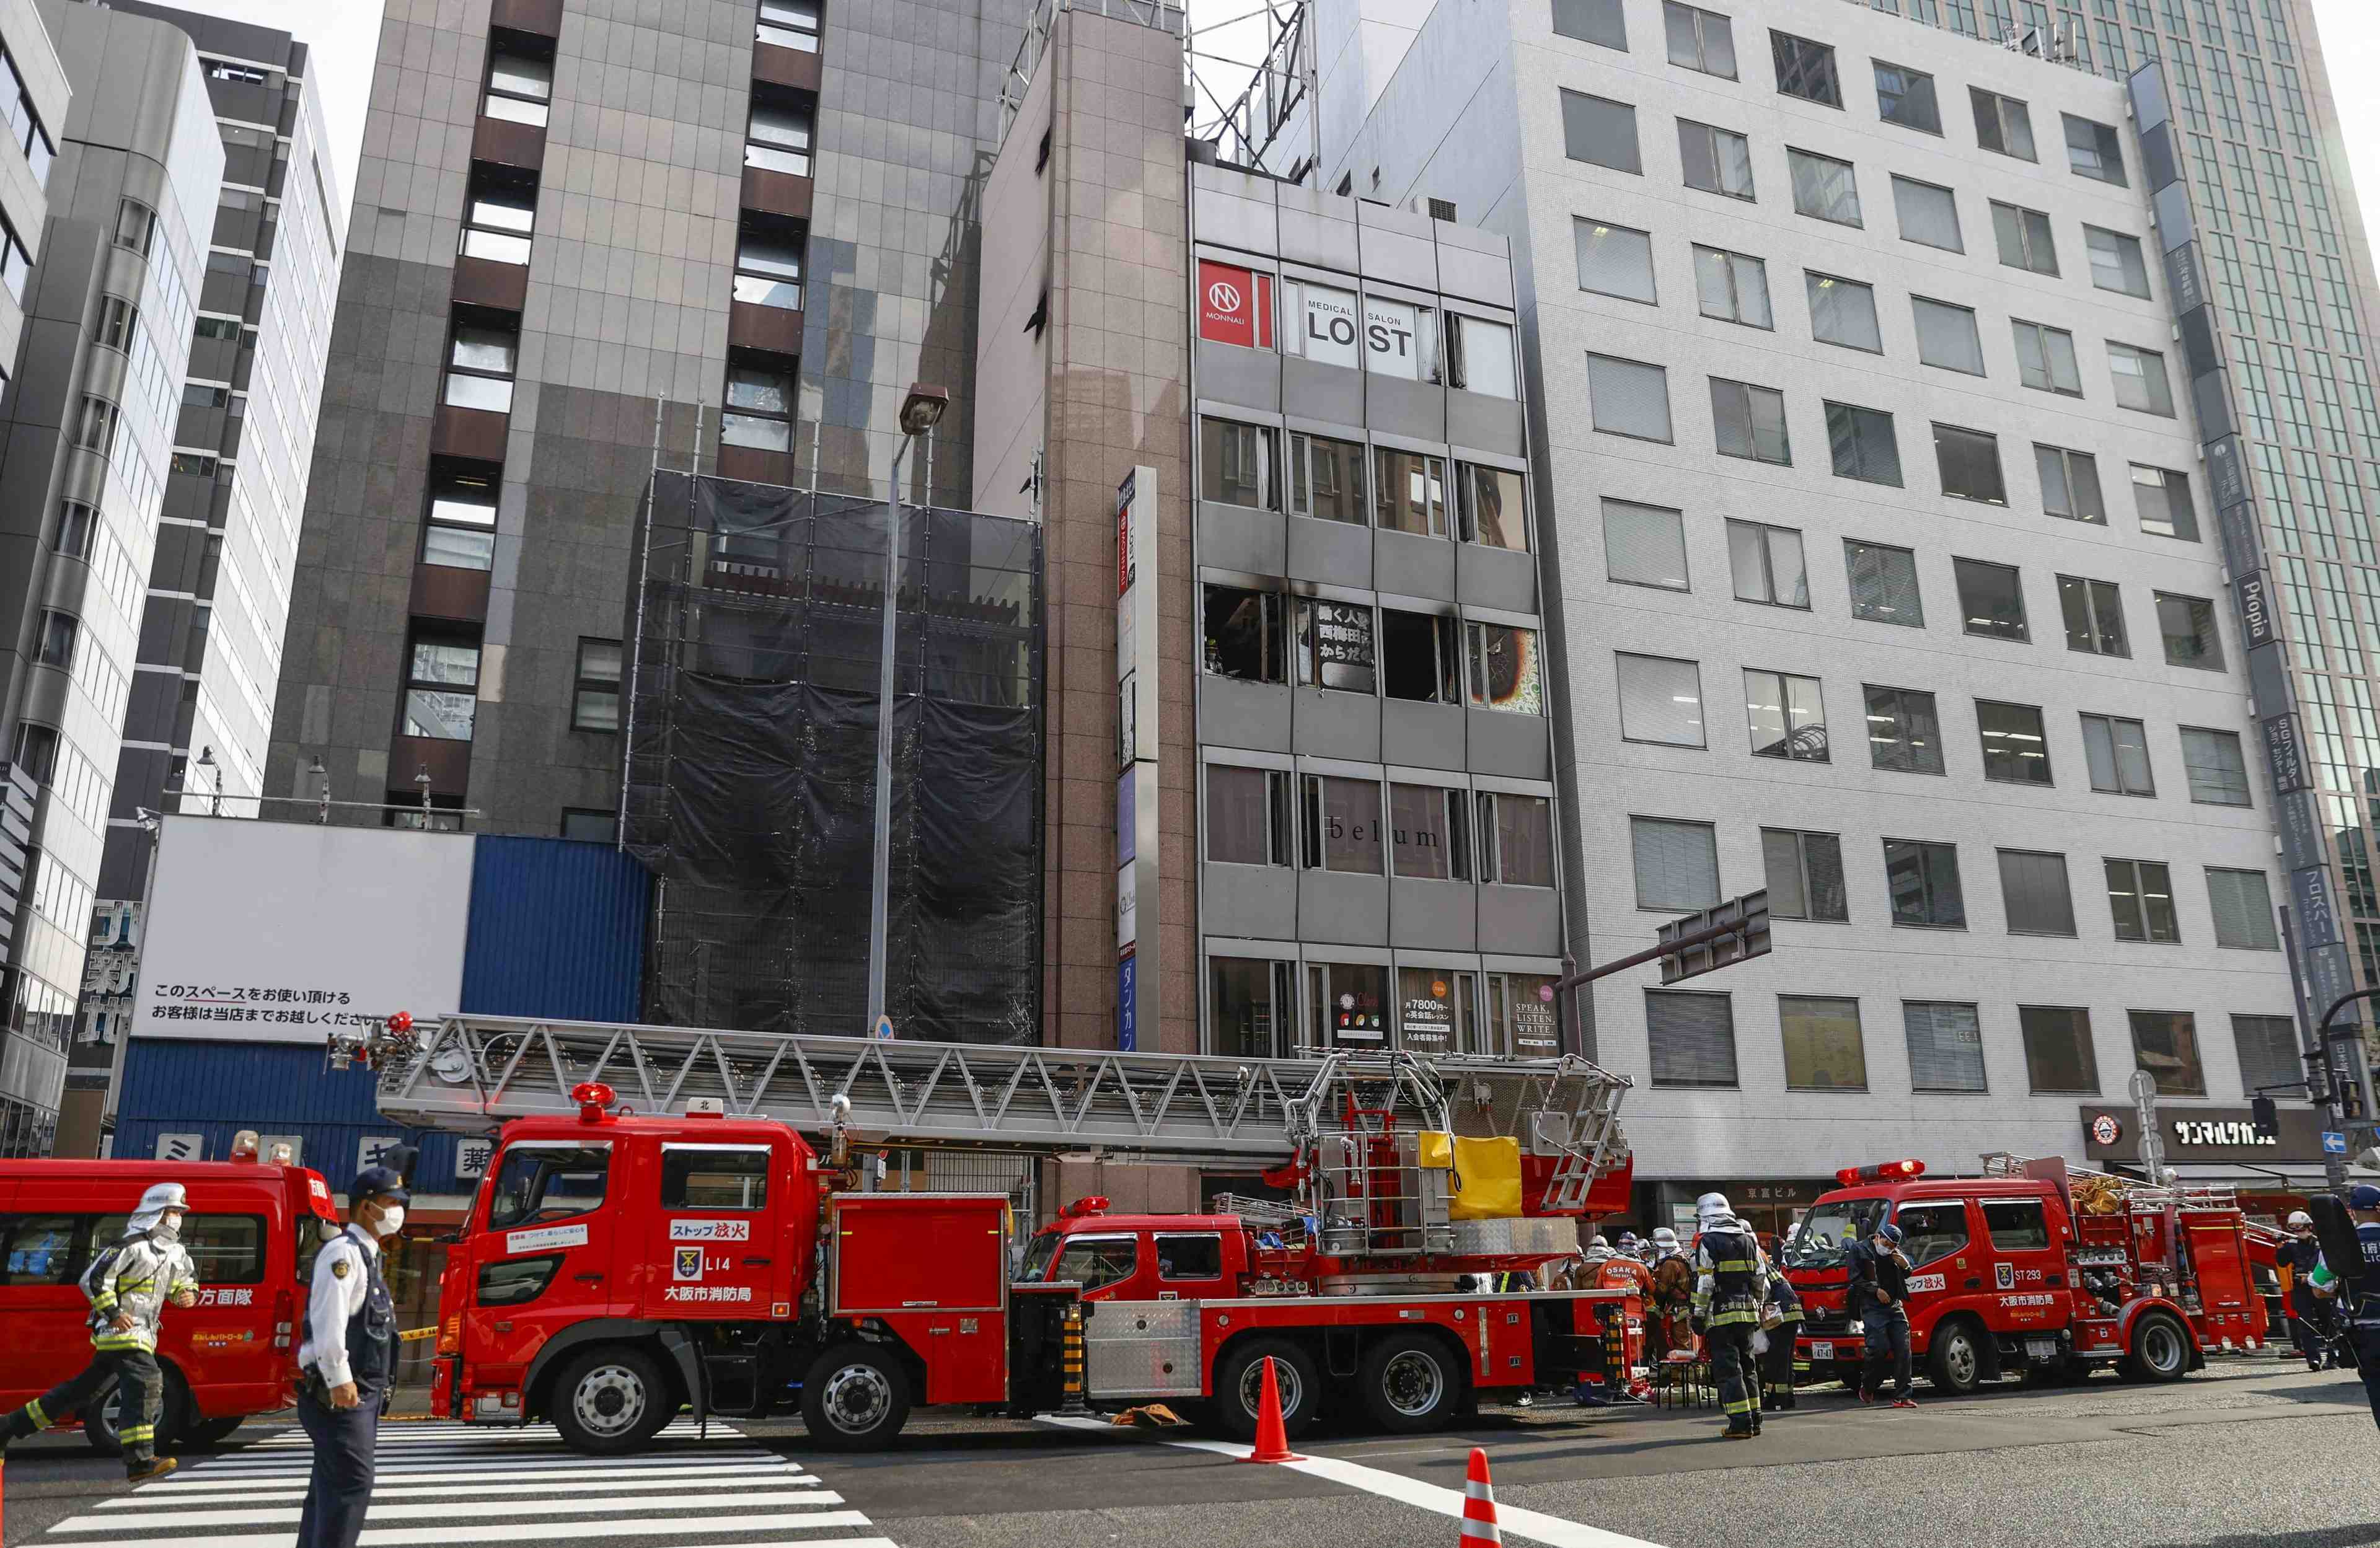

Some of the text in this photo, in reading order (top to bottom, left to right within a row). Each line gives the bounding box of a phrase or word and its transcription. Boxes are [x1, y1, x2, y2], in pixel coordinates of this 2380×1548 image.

[1206, 312, 1245, 325] MONNALI
[1308, 301, 1401, 325] MEDICAL SALON
[1308, 312, 1412, 356] LOST
[2244, 581, 2268, 638] propia
[1329, 816, 1439, 847] belum
[155, 984, 350, 1005] このスペースをお使い頂ける
[1517, 1024, 1554, 1034] WRITE.
[700, 1100, 710, 1110] 北
[1748, 1187, 1797, 1198] 京富ビル
[674, 1222, 746, 1238] ストップ放火
[705, 1257, 730, 1270] L14
[1606, 1266, 1637, 1275] OSAKA
[2015, 1270, 2042, 1280] ST 293
[198, 1288, 253, 1306] 方面隊
[664, 1286, 752, 1302] 大阪市消防局
[1999, 1295, 2055, 1307] 大阪市消防局
